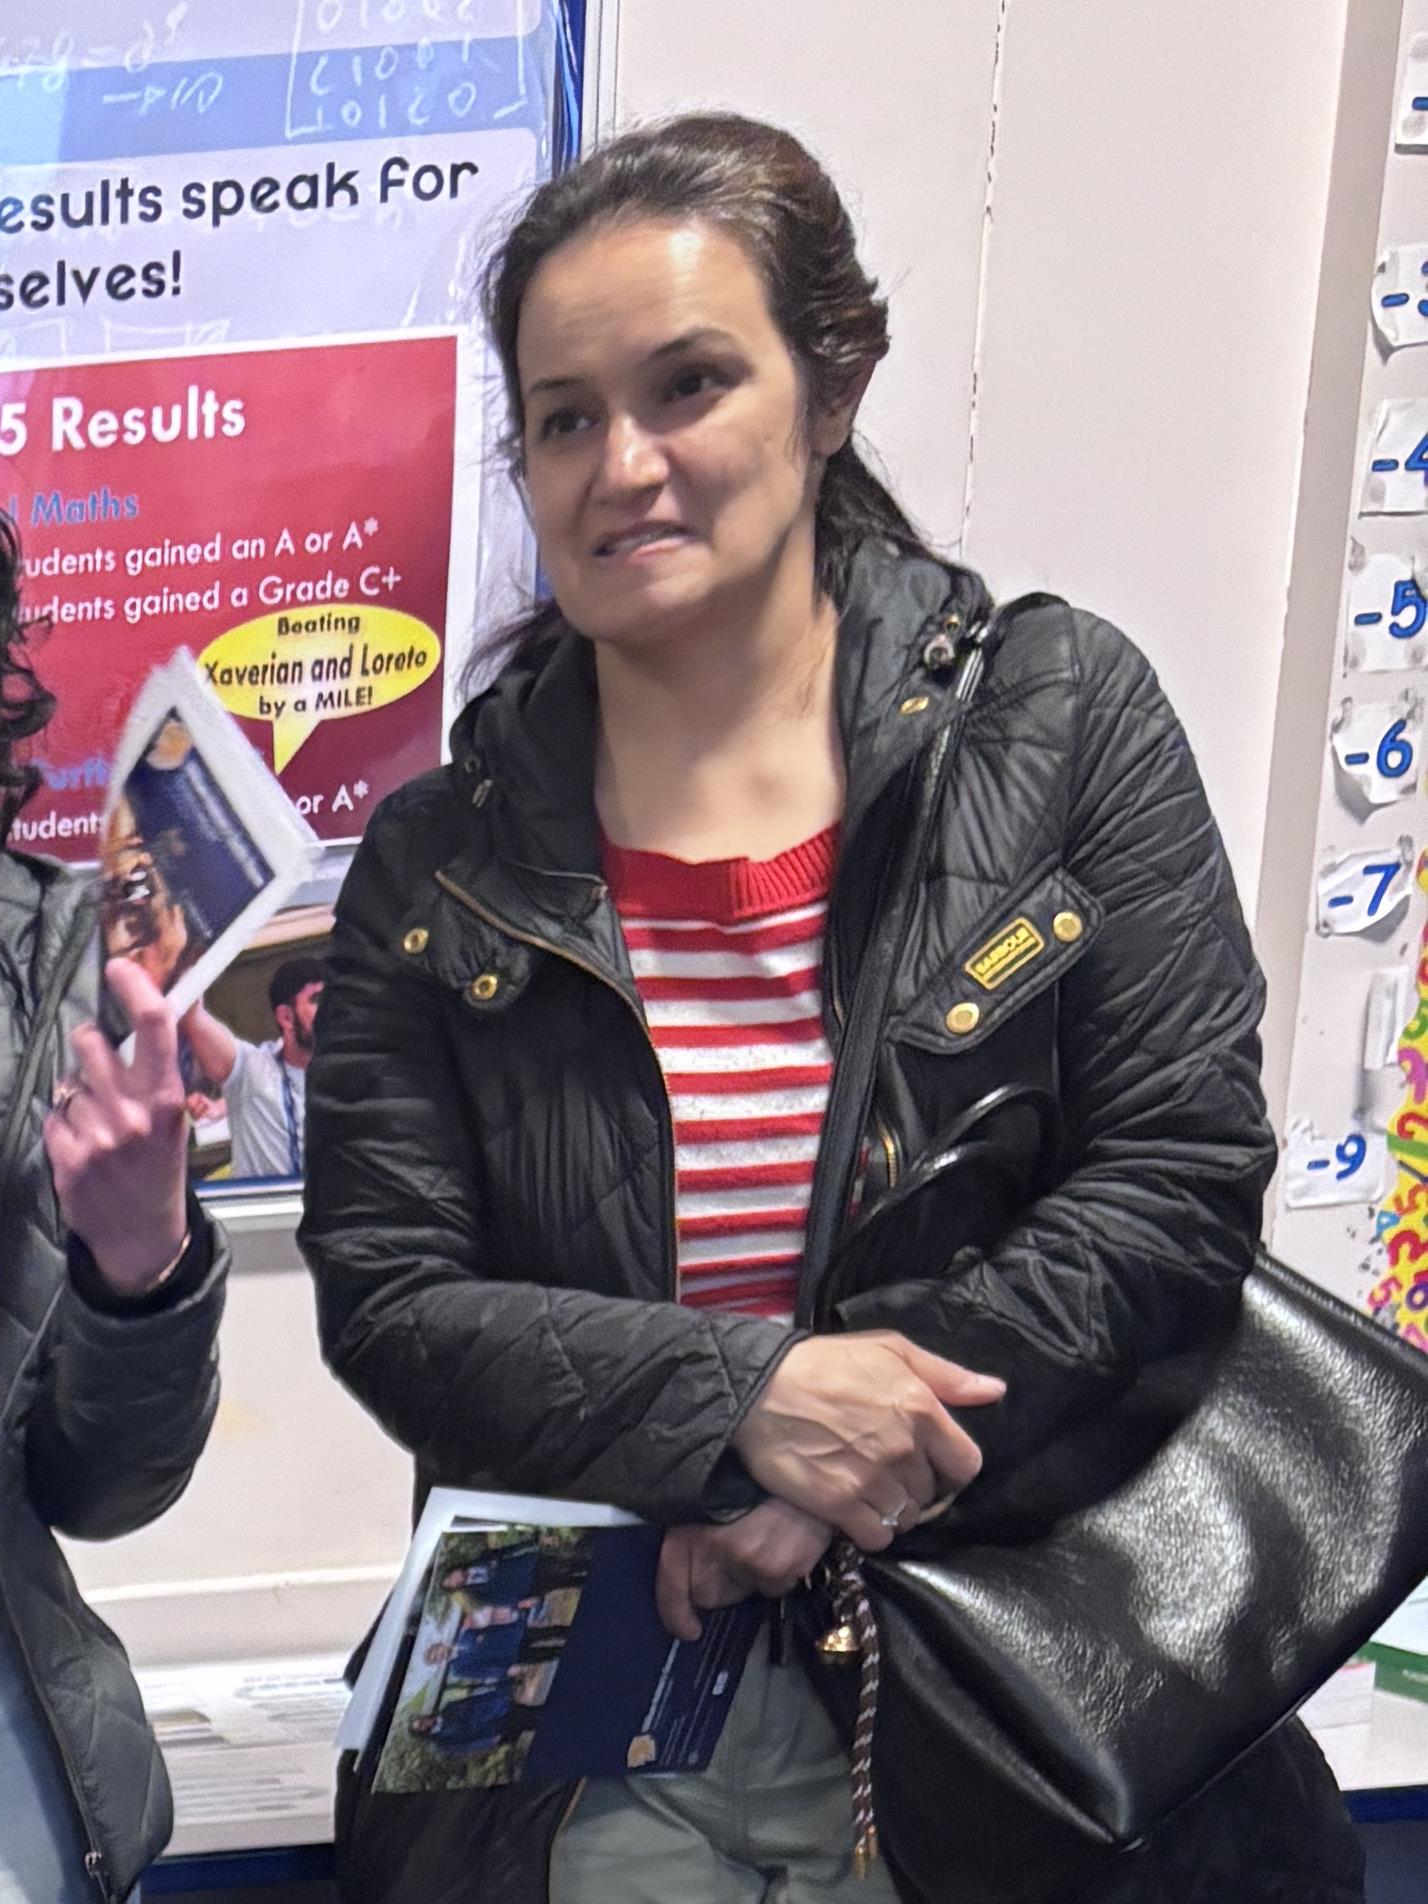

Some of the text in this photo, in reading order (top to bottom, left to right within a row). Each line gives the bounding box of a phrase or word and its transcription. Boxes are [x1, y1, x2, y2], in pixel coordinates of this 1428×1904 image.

[181, 162, 360, 228] speak
[378, 152, 477, 205] for
[51, 384, 246, 453] Results
[30, 488, 140, 528] Maths
[20, 541, 116, 579] udents
[125, 533, 222, 576] gained
[231, 535, 266, 559] an
[273, 528, 296, 557] A
[305, 530, 333, 553] or
[22, 566, 402, 626] udents gained a Grade C+
[1353, 579, 1427, 641] -5
[277, 612, 361, 637] Beating
[204, 642, 428, 688] Xaverian and Loreto
[258, 685, 373, 719] by a MILE!
[1344, 718, 1414, 779] -6
[10, 810, 104, 841] tudent
[1327, 861, 1401, 917] -7
[1306, 1132, 1367, 1181] -9
